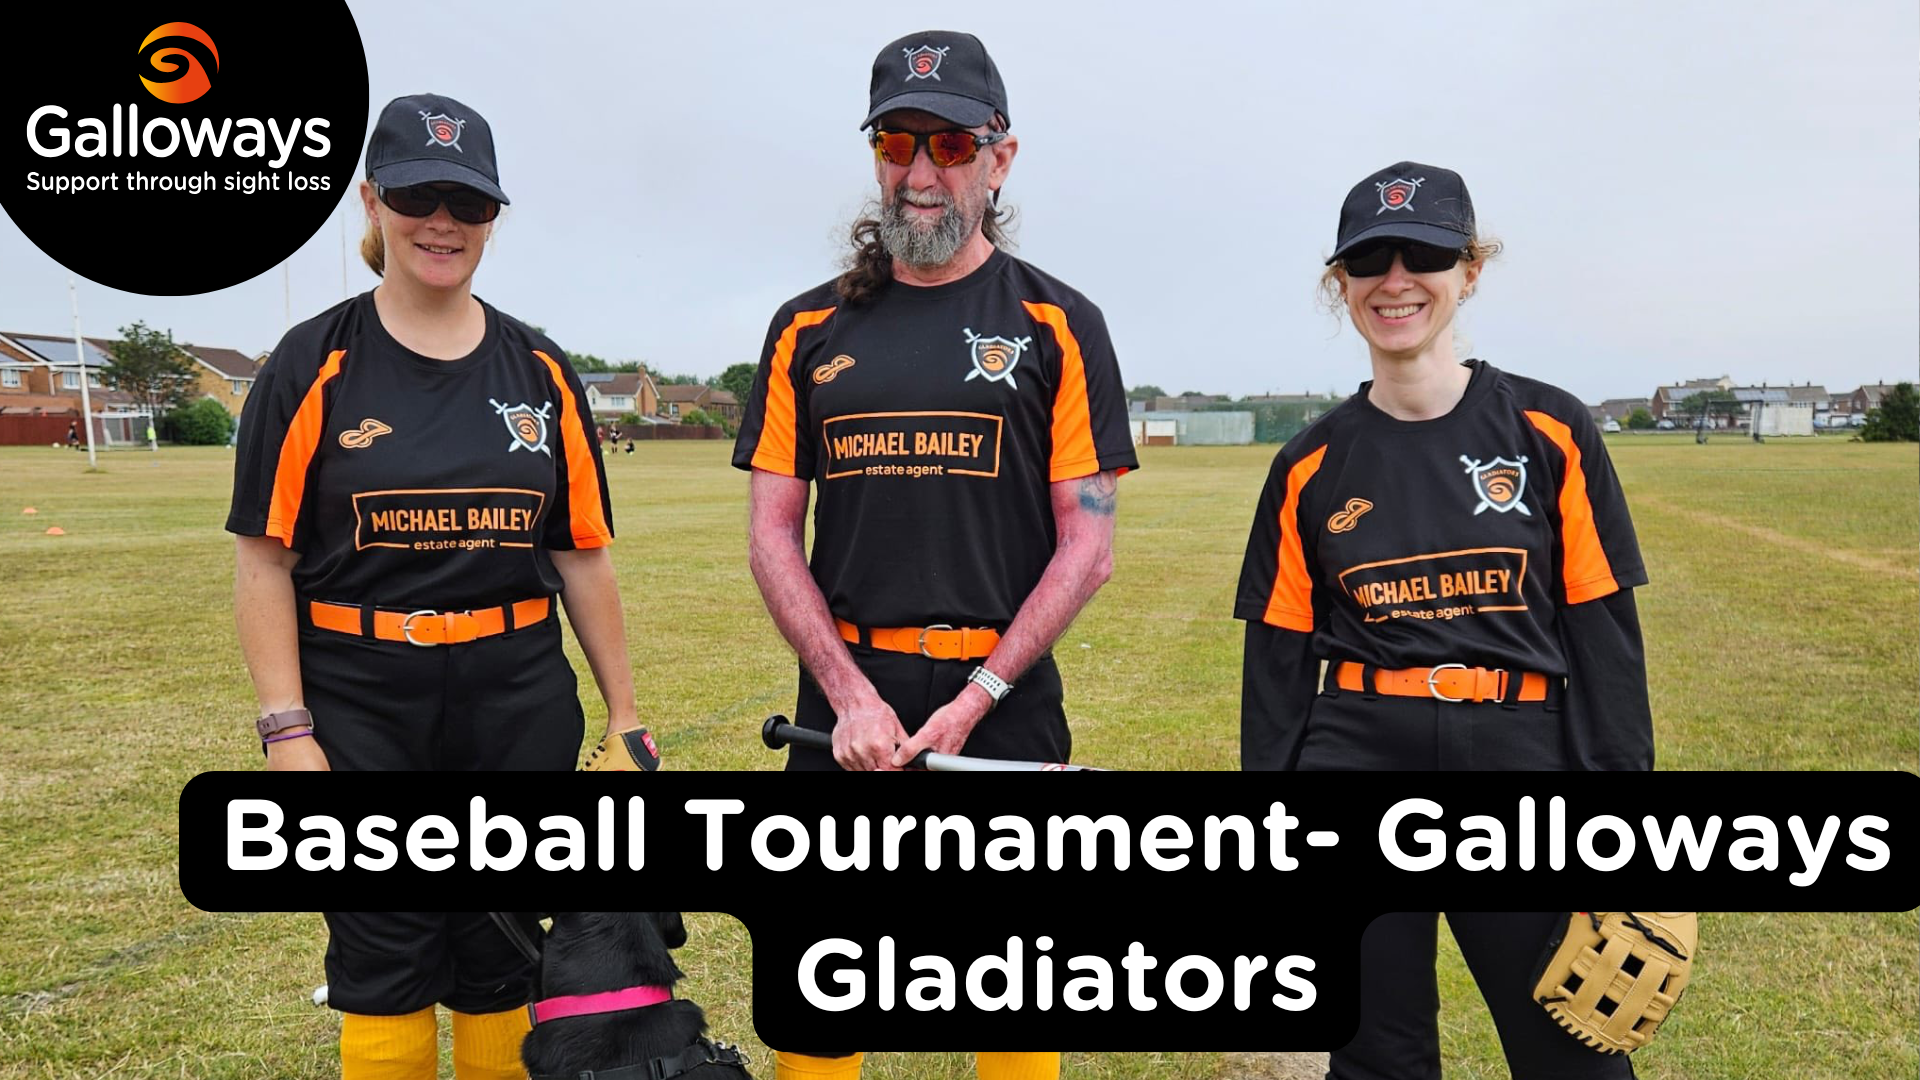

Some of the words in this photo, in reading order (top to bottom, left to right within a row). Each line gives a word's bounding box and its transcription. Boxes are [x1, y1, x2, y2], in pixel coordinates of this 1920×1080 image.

[833, 432, 910, 460] MICHAEL
[915, 432, 984, 458] BAILEY
[865, 465, 906, 476] estate
[906, 464, 944, 478] agent
[371, 508, 463, 533] MICHAEL
[467, 507, 532, 532] BAILEY
[413, 538, 457, 550] estate
[458, 538, 496, 551] agent
[1353, 576, 1438, 608] MICHAEL
[1440, 568, 1511, 598] BAILEY
[1435, 604, 1475, 620] agent
